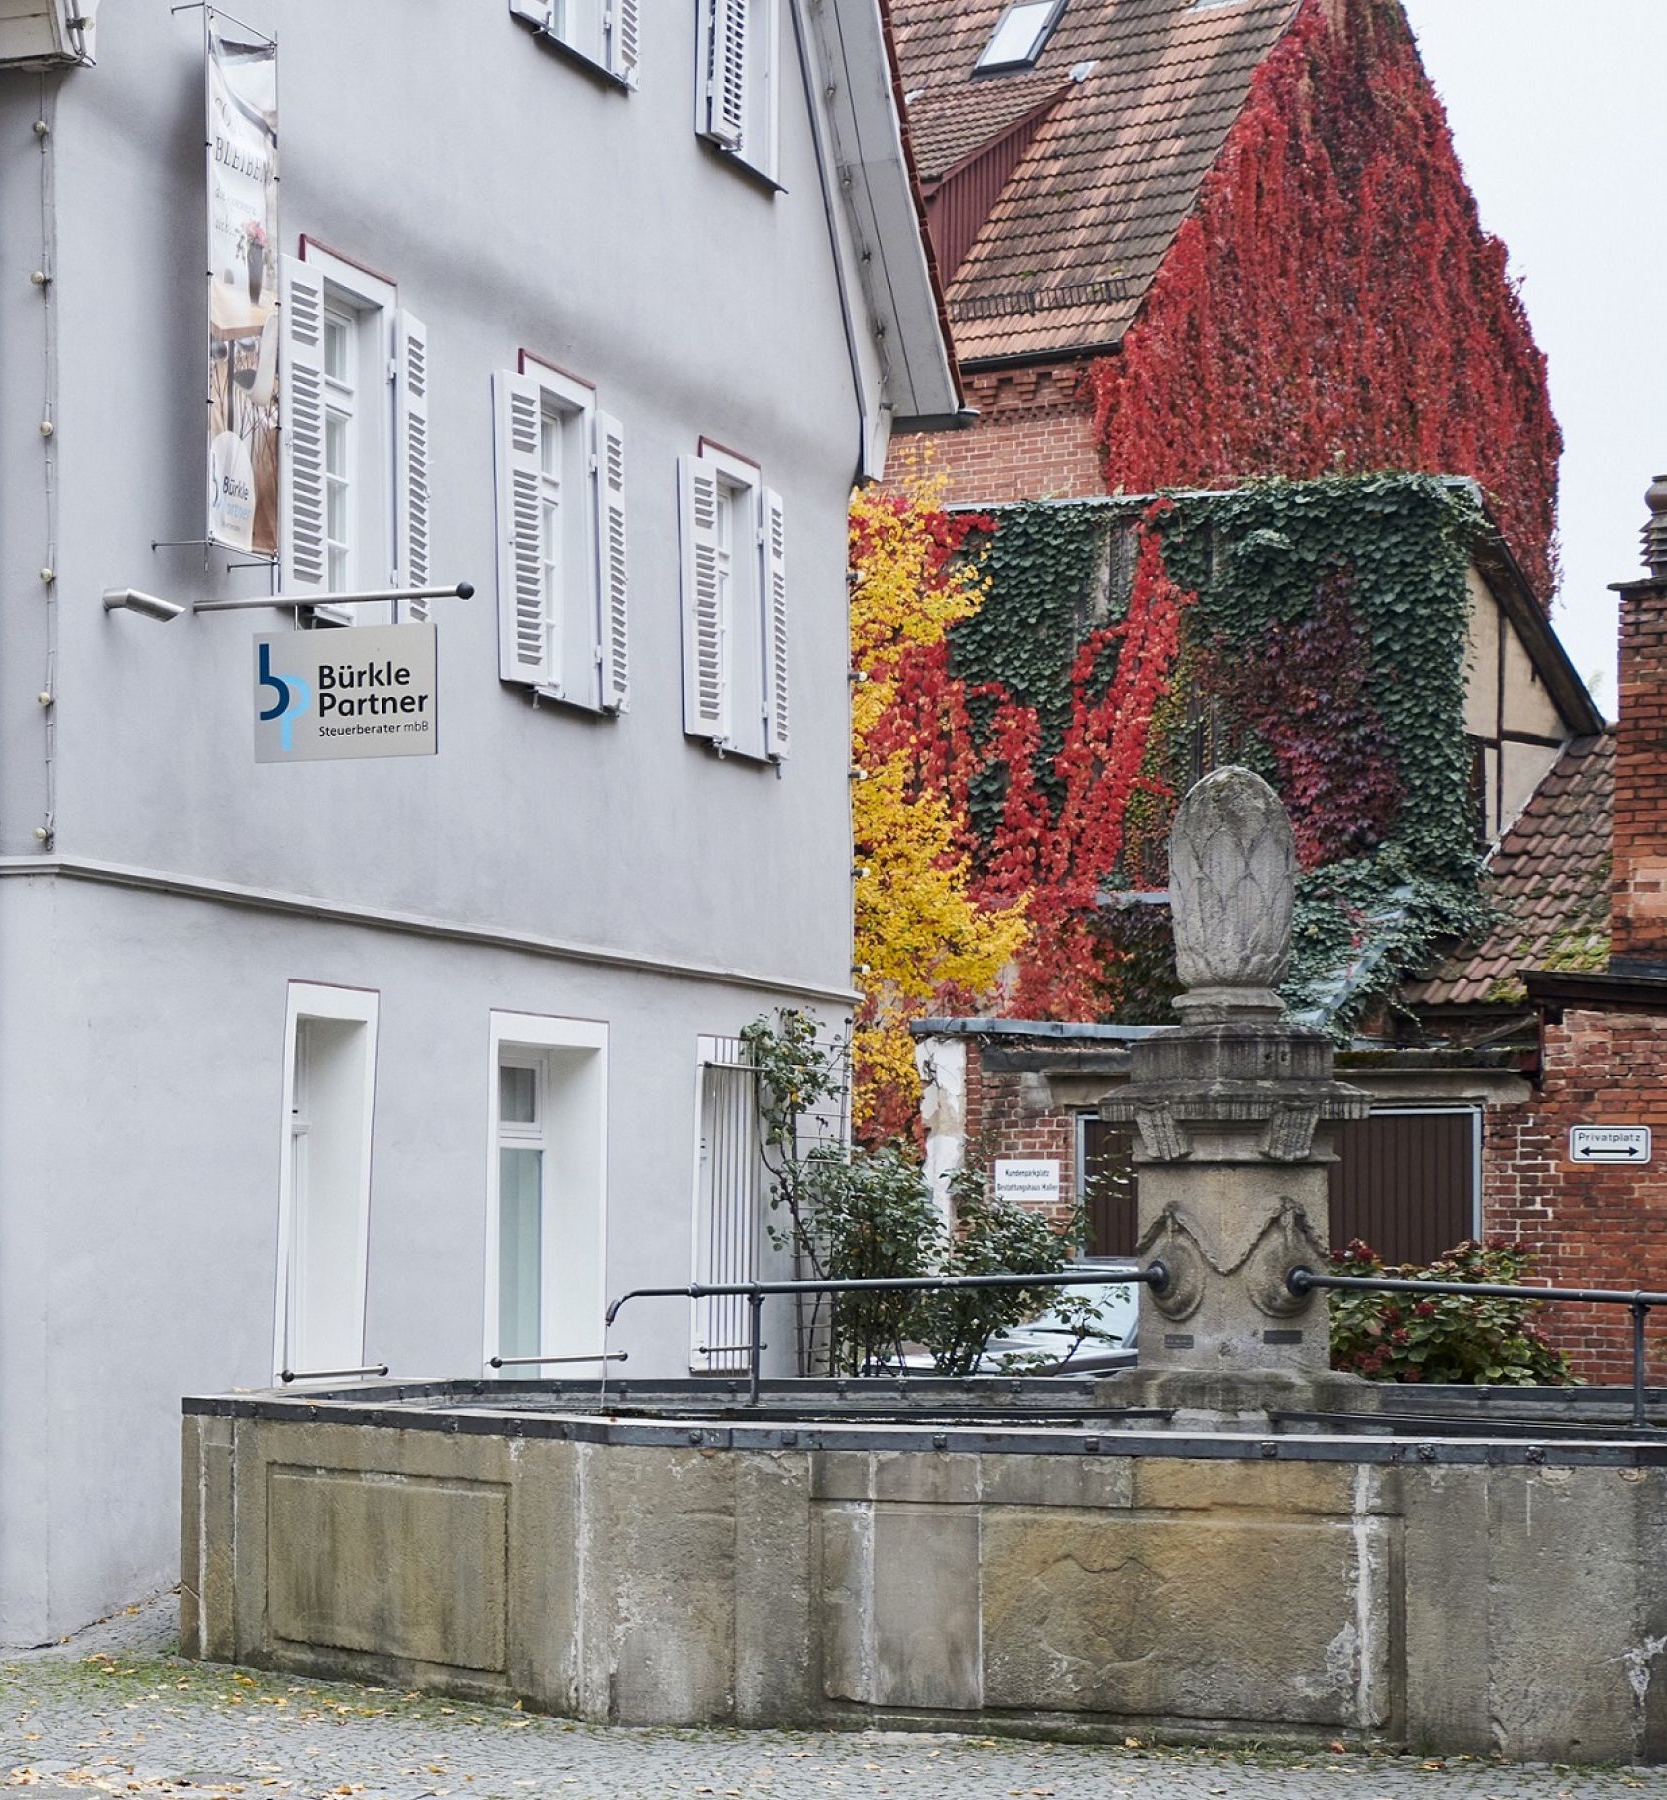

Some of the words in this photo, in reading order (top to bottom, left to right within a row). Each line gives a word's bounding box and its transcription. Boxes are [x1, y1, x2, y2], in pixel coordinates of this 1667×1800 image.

[223, 476, 250, 500] Bürkle
[318, 661, 411, 690] Bürkle
[318, 693, 429, 718] Partner
[318, 724, 400, 737] Steuerberater
[404, 721, 429, 733] mbB
[1578, 1132, 1641, 1143] Privatplatz
